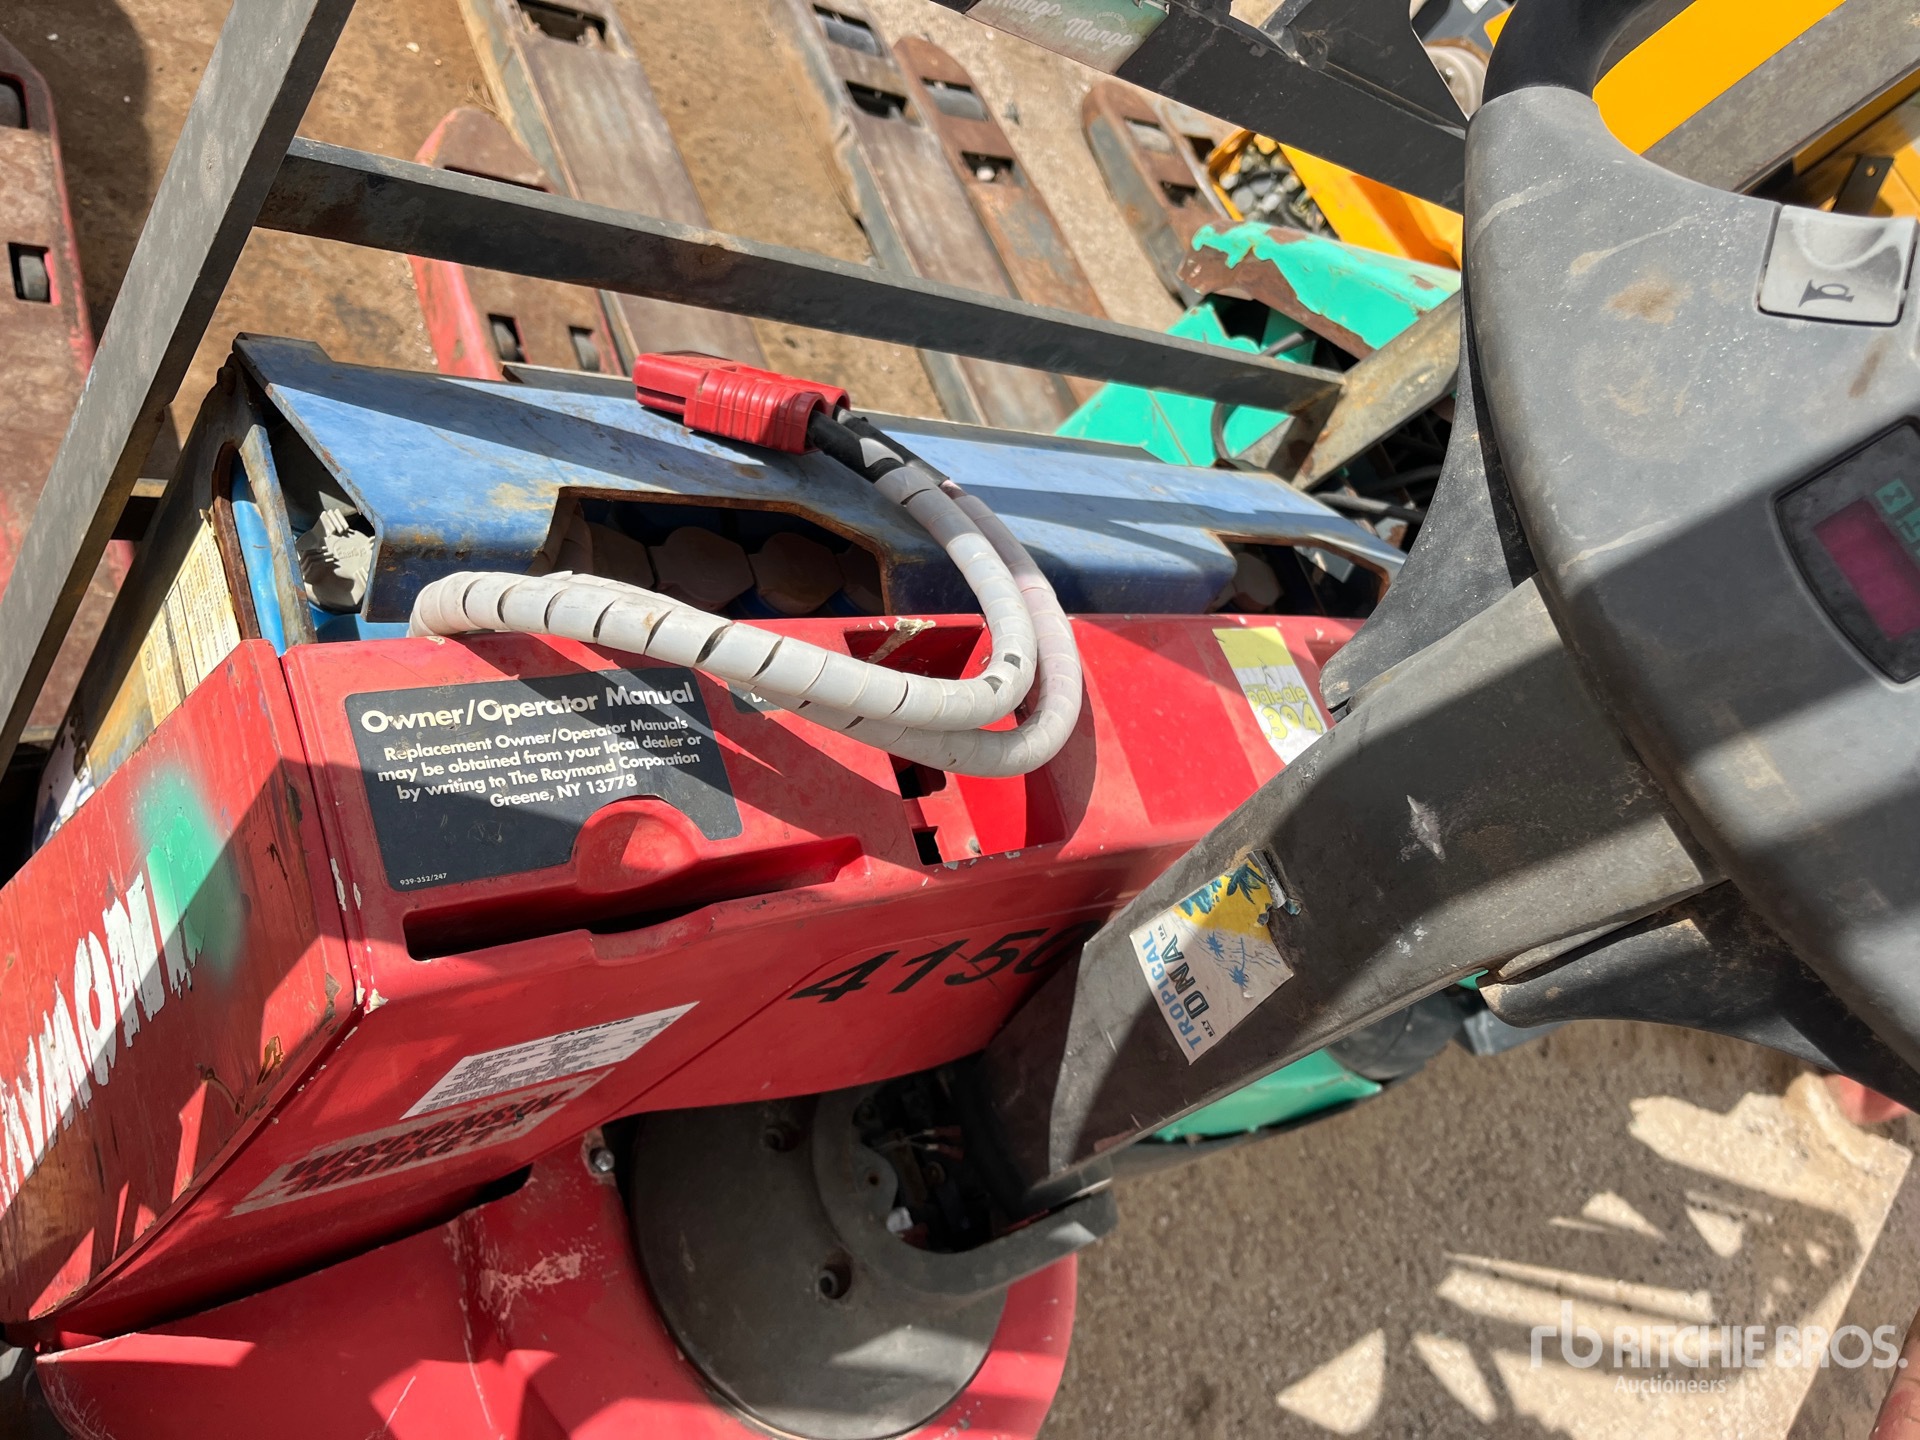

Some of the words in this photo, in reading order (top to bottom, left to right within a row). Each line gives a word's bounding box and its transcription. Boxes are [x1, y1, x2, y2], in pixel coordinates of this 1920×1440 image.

[1064, 17, 1134, 52] Mango
[361, 694, 598, 733] Owner/Operator
[605, 681, 694, 707] Manual
[378, 766, 417, 782] may
[421, 762, 445, 777] be
[448, 751, 521, 774] obtained
[523, 750, 562, 765] from
[565, 745, 601, 763] your
[603, 736, 640, 755] local
[642, 735, 684, 749] dealer
[687, 735, 702, 746] or
[384, 737, 492, 762] Replacement
[495, 722, 627, 748] Owner/Operator
[630, 716, 688, 732] Manuals
[397, 784, 421, 802] by
[425, 777, 486, 794] writing
[488, 776, 506, 789] to
[508, 769, 538, 786] The
[540, 758, 617, 782] Raymond
[619, 752, 701, 770] Corporation
[490, 790, 554, 808] Greene,
[556, 782, 581, 799] NY
[586, 773, 638, 795] 13778
[1142, 930, 1203, 1050] TROPICAL
[1161, 934, 1209, 1020] DNA
[281, 1088, 574, 1183] WISCONSIN
